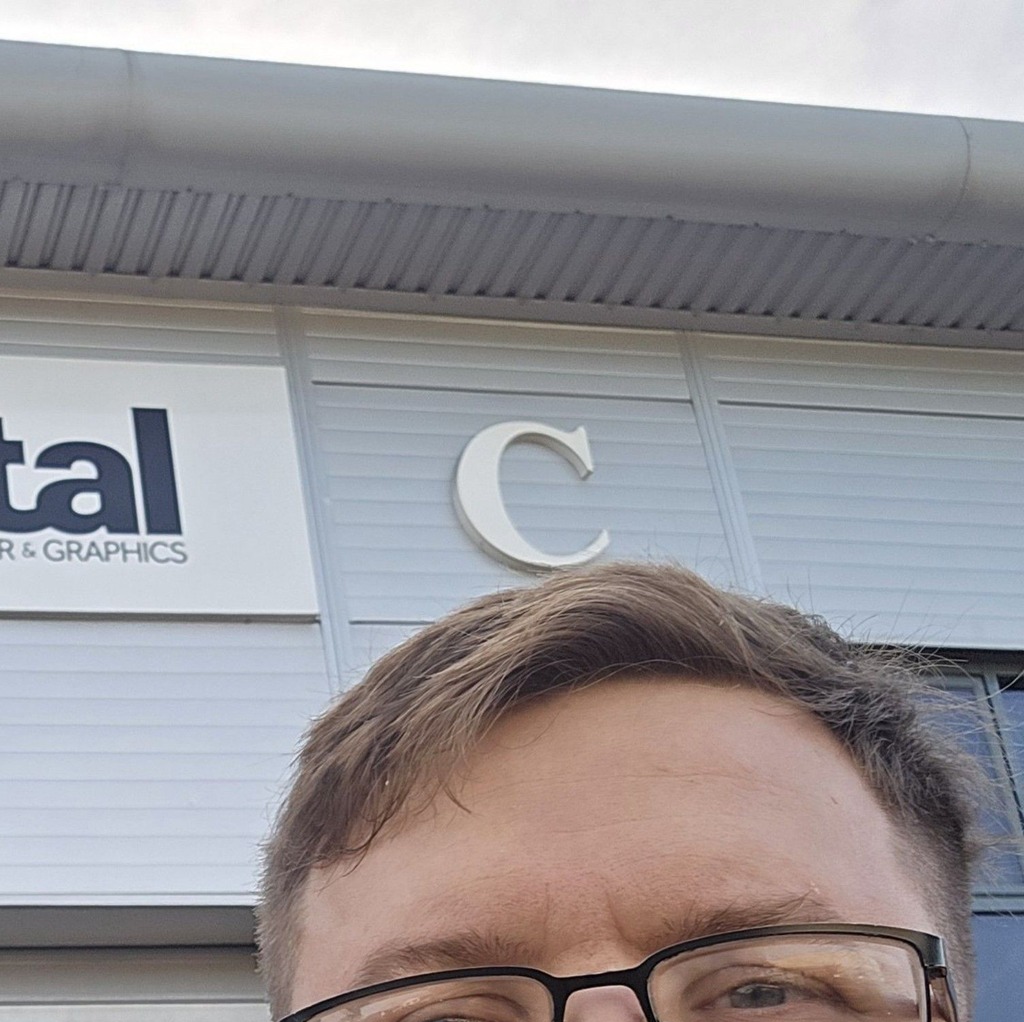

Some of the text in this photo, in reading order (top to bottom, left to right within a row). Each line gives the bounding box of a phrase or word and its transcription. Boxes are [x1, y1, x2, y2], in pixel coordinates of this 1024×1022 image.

[453, 419, 611, 573] C
[21, 542, 37, 559] &
[42, 539, 188, 564] GRAPHICS
